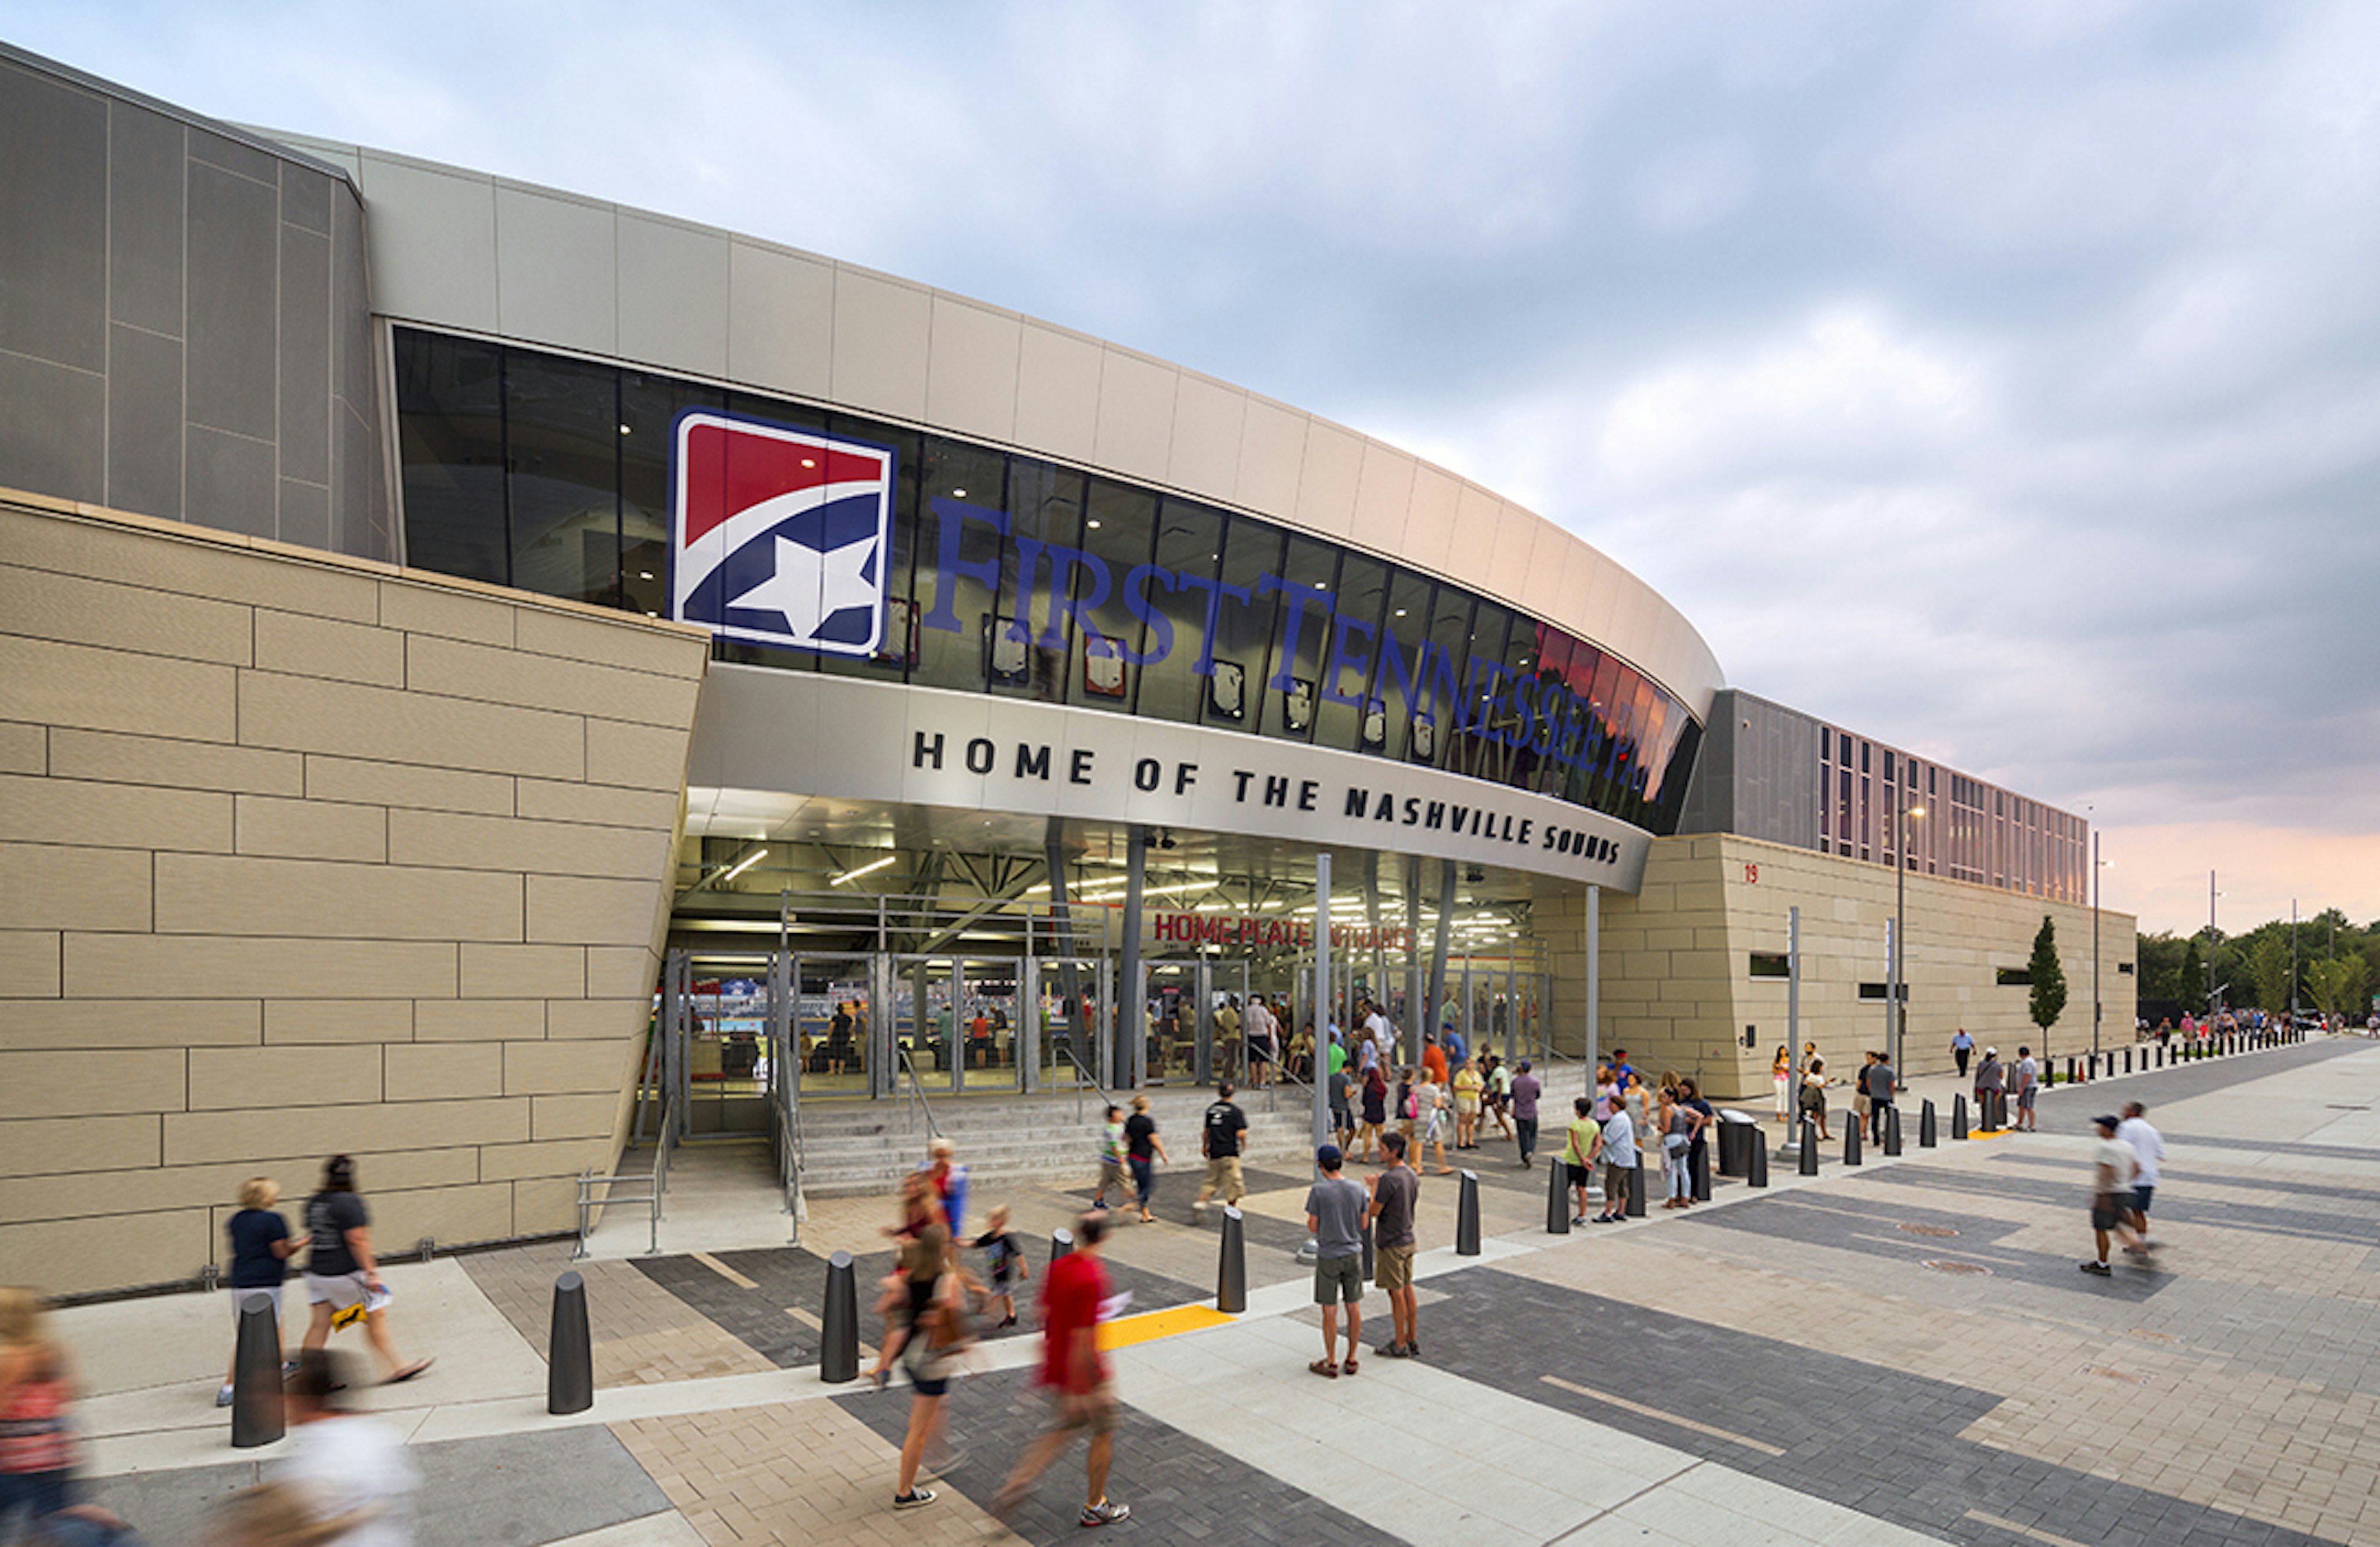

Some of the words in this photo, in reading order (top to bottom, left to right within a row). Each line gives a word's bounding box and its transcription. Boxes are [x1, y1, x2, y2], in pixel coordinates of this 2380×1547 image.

[923, 495, 1251, 676] FIRST
[1258, 570, 1608, 774] TENNESSEE
[1604, 702, 1677, 805] PA
[913, 731, 1094, 785] HOME
[1135, 758, 1199, 795] OF
[1234, 770, 1320, 811] THE
[1344, 787, 1534, 844] NASHVILLE
[1543, 826, 1619, 864] SOUNDS
[1746, 864, 1758, 883] 19
[1155, 914, 1232, 943] HOME
[1239, 916, 1310, 947] PLATE
[1328, 923, 1414, 952] NTRANCE
